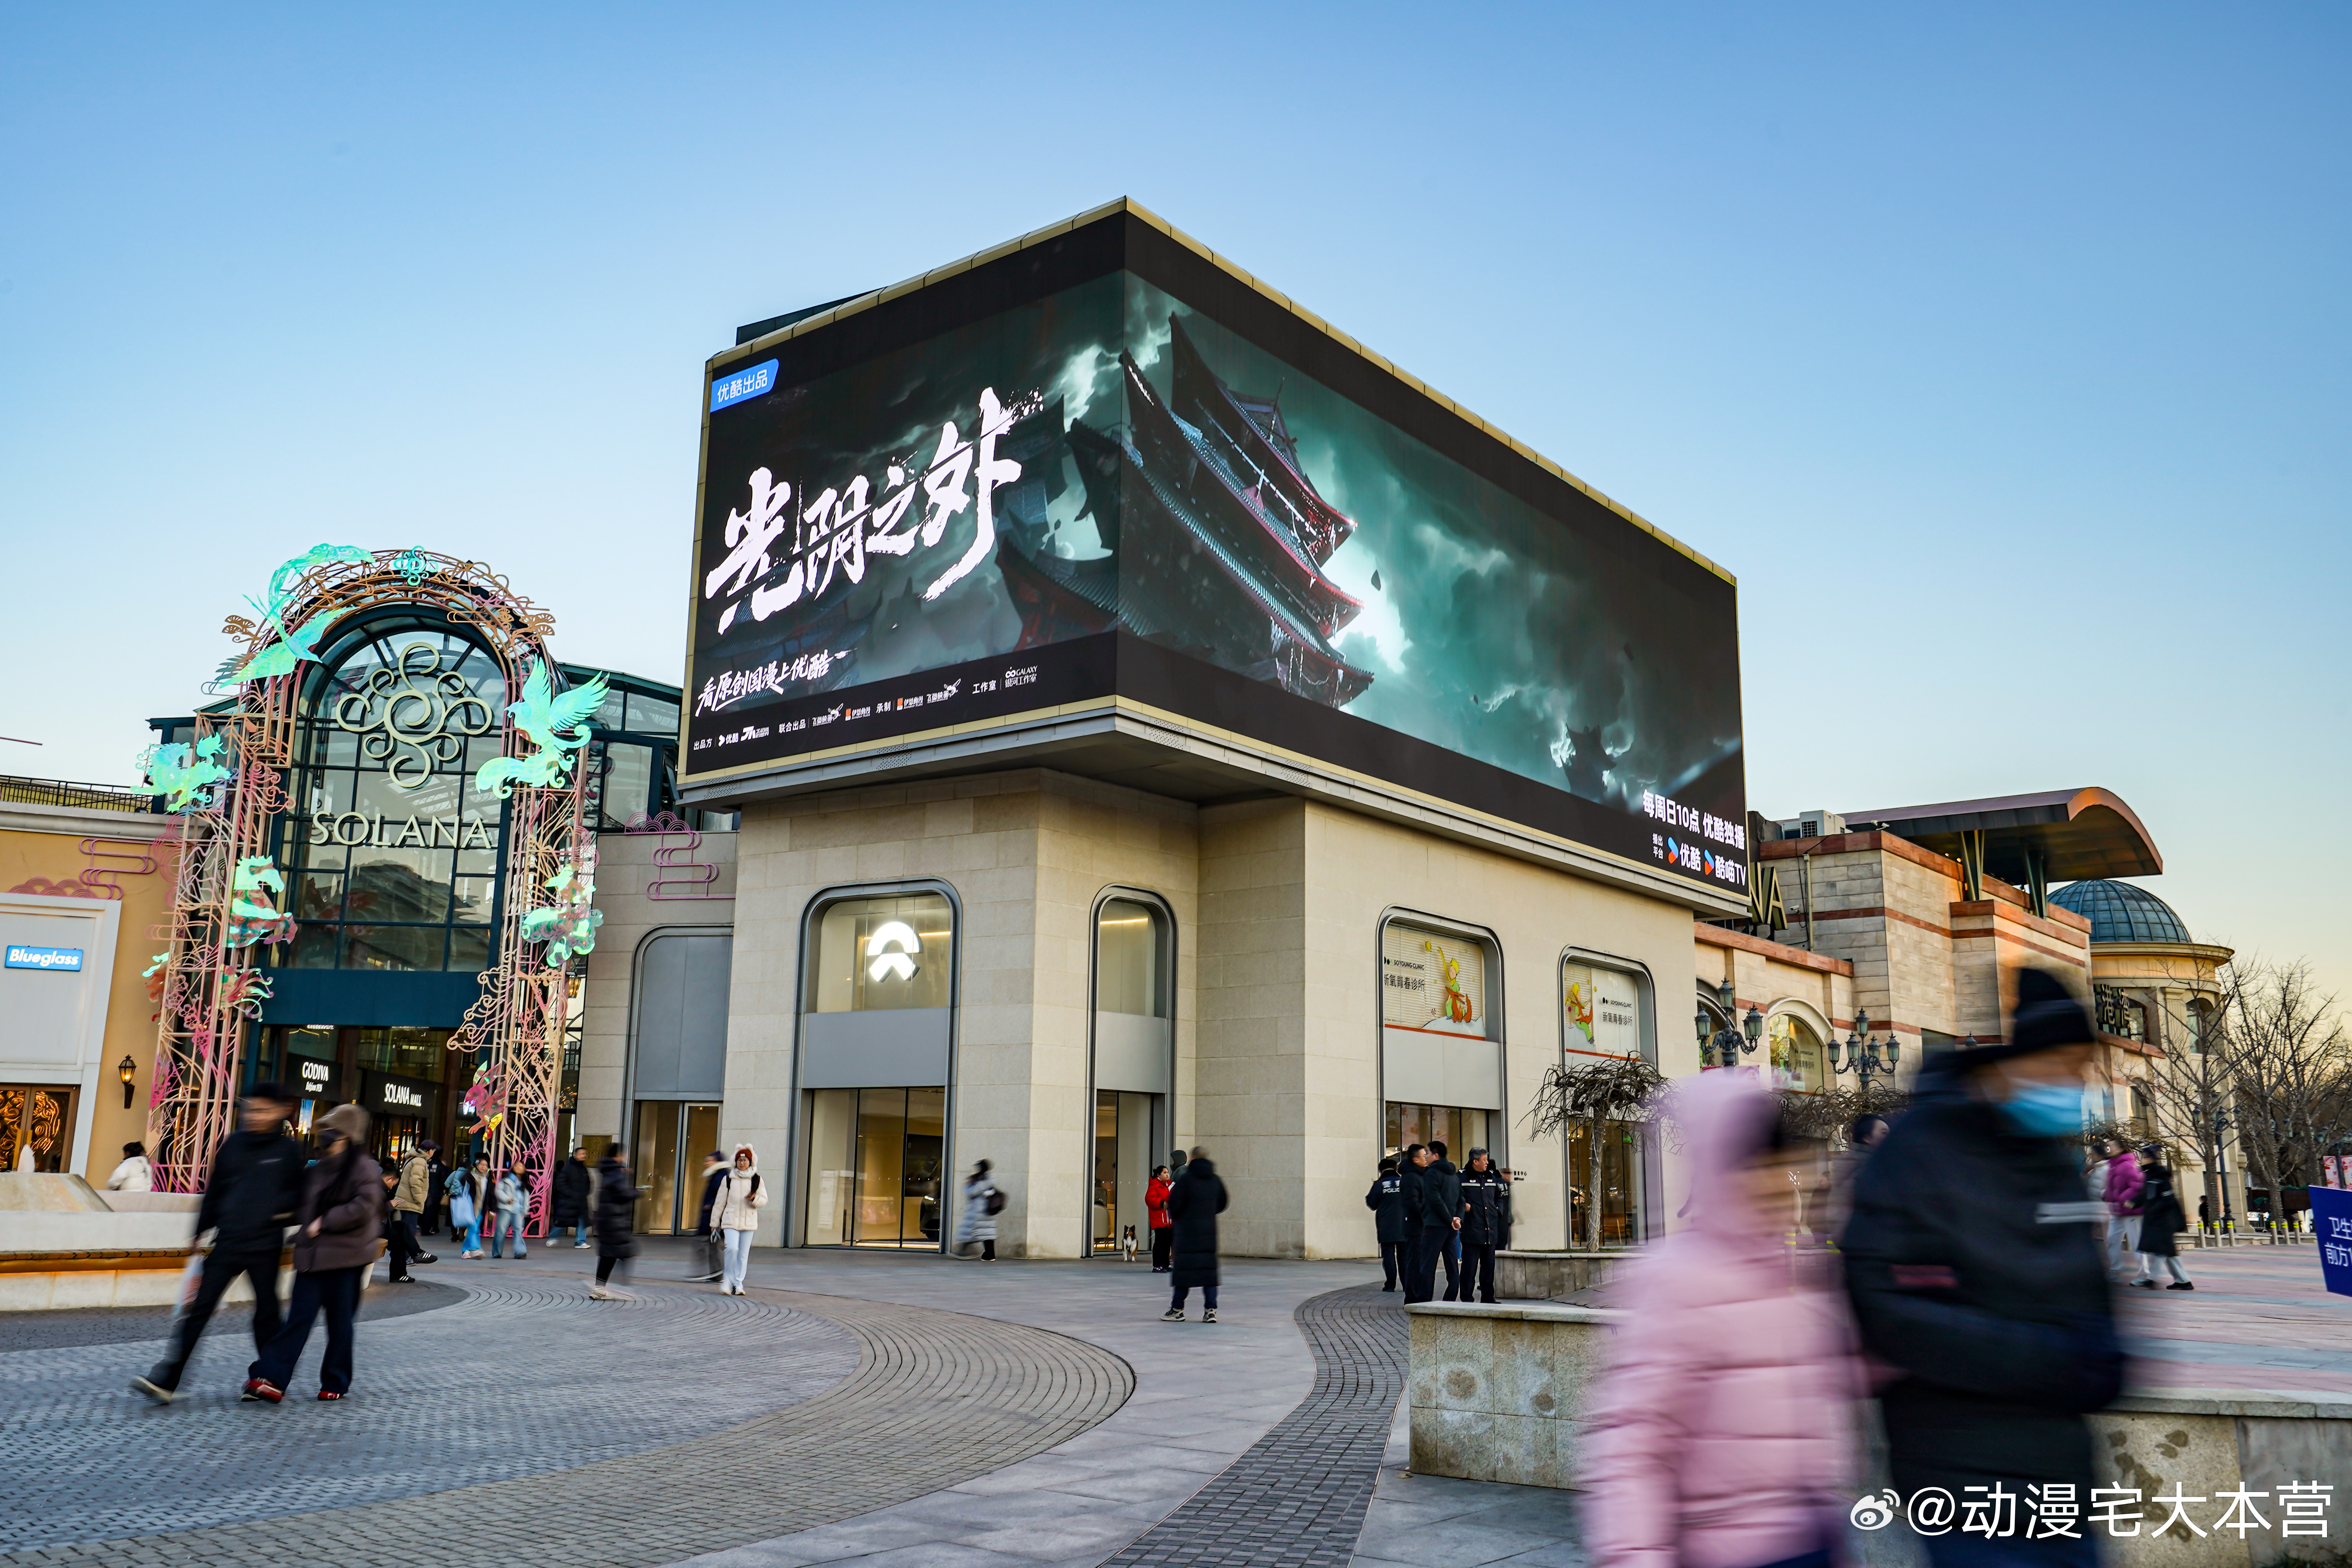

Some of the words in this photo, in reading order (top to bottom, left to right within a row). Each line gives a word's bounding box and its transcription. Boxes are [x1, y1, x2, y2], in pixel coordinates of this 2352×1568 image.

[717, 369, 768, 404] 优酷出品
[705, 387, 1034, 636] 光阴之外
[1016, 666, 1037, 676] GALAXY
[695, 649, 846, 717] 看原创国漫上优酷
[972, 680, 997, 694] 工作室
[876, 701, 891, 713] 承制
[778, 718, 806, 734] 联合出品
[693, 738, 712, 751] 出品方
[726, 732, 739, 744] 优酷
[1642, 789, 1700, 834] 每周日10点
[1702, 812, 1745, 850] 优酷独播
[309, 811, 491, 849] SOLANA
[1653, 846, 1664, 859] 平台
[1680, 843, 1701, 872] 优酷
[1714, 855, 1746, 886] 酷喵TV
[9, 949, 79, 967] Blueglass
[1394, 960, 1413, 968] SOYOUNG
[1384, 974, 1425, 992] 新氧青春诊所
[302, 1061, 329, 1081] GODIVA
[384, 1083, 410, 1105] SOLANA
[410, 1093, 422, 1107] MALL
[2328, 1217, 2352, 1240] 卫生
